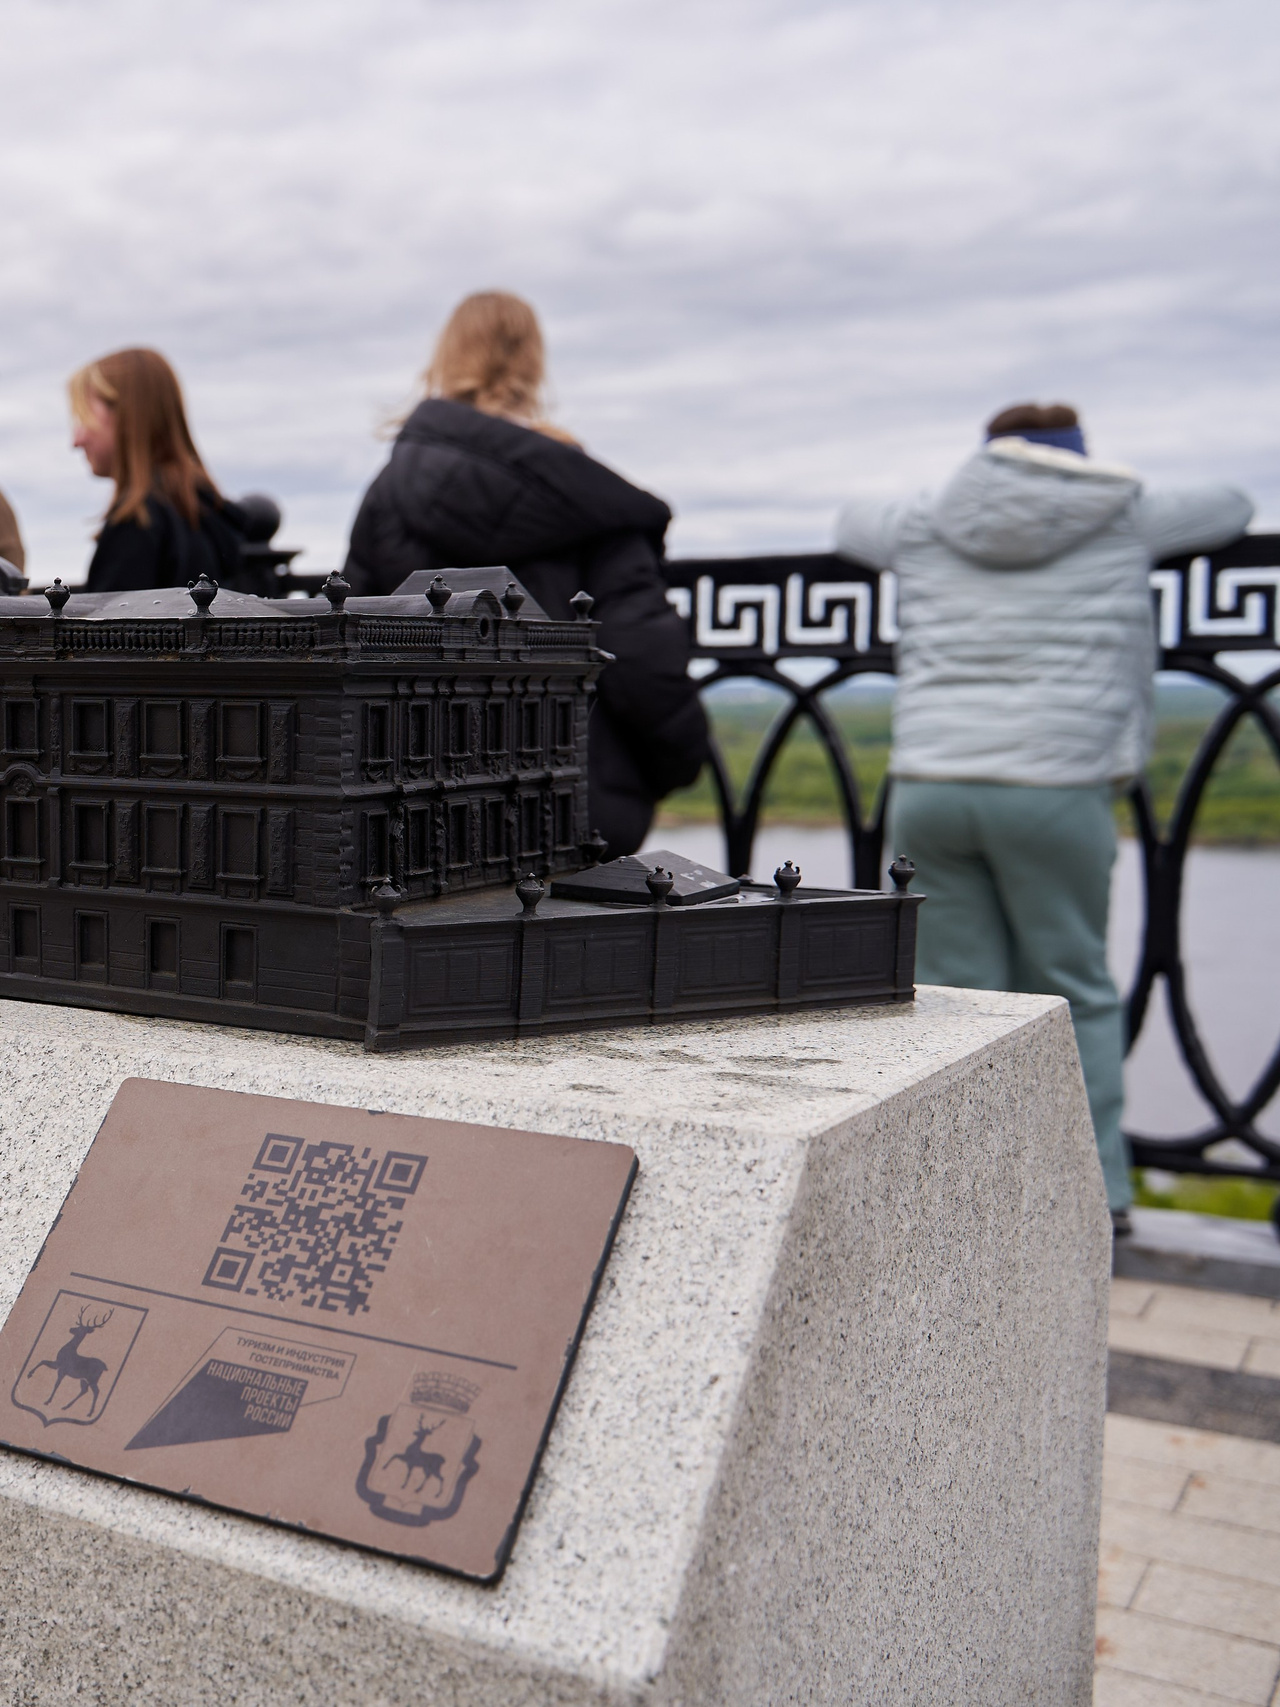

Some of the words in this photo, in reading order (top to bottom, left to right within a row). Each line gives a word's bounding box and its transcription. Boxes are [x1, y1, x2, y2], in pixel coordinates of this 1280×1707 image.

[237, 1337, 275, 1352] ТУРИЗМ
[276, 1345, 285, 1356] И
[286, 1348, 346, 1368] ИНДУСТРИЯ
[249, 1352, 340, 1380] ГОСТЕПРИИМСТВА
[206, 1361, 306, 1396] НАЦИОНАЛЬНЫЕ
[240, 1386, 299, 1412] ПРОЕКТЫ
[243, 1404, 293, 1428] РОССИИ
